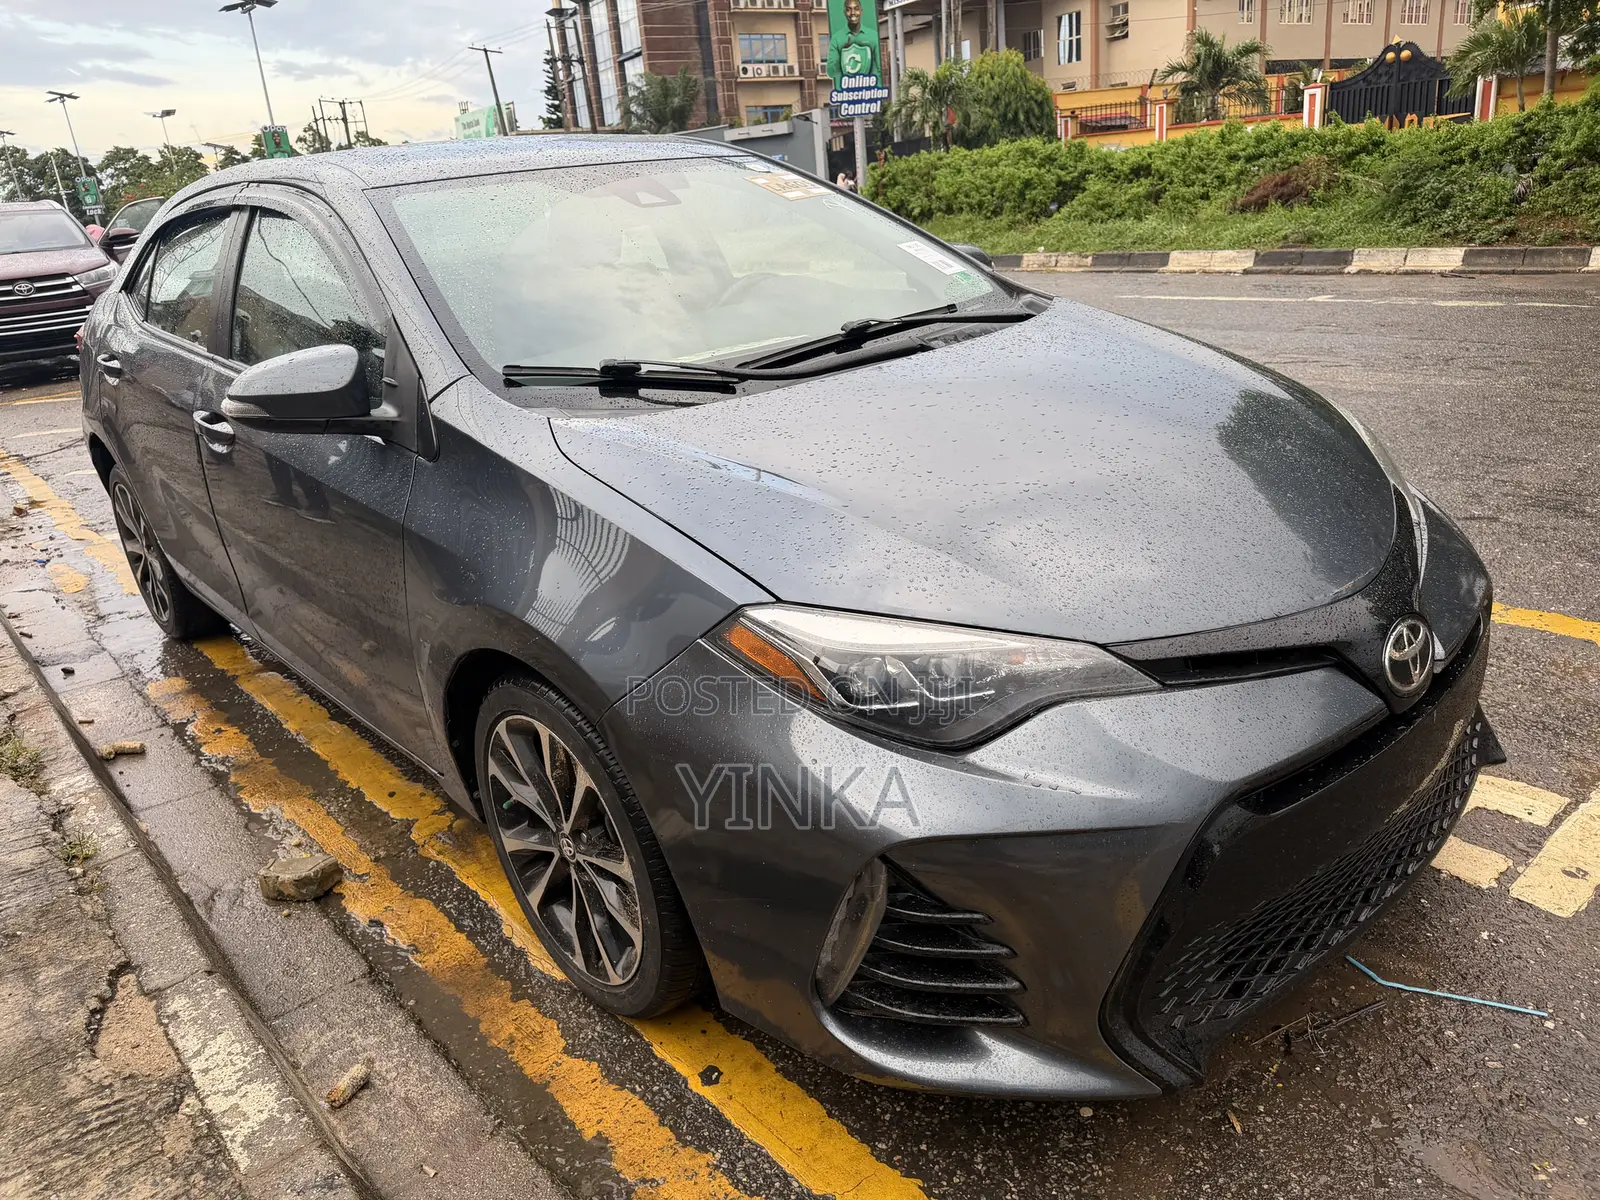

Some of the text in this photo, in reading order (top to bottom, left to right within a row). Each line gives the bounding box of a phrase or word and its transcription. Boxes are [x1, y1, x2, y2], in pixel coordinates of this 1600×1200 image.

[841, 75, 877, 89] Online
[831, 89, 888, 102] Subscription
[841, 101, 881, 115] Control
